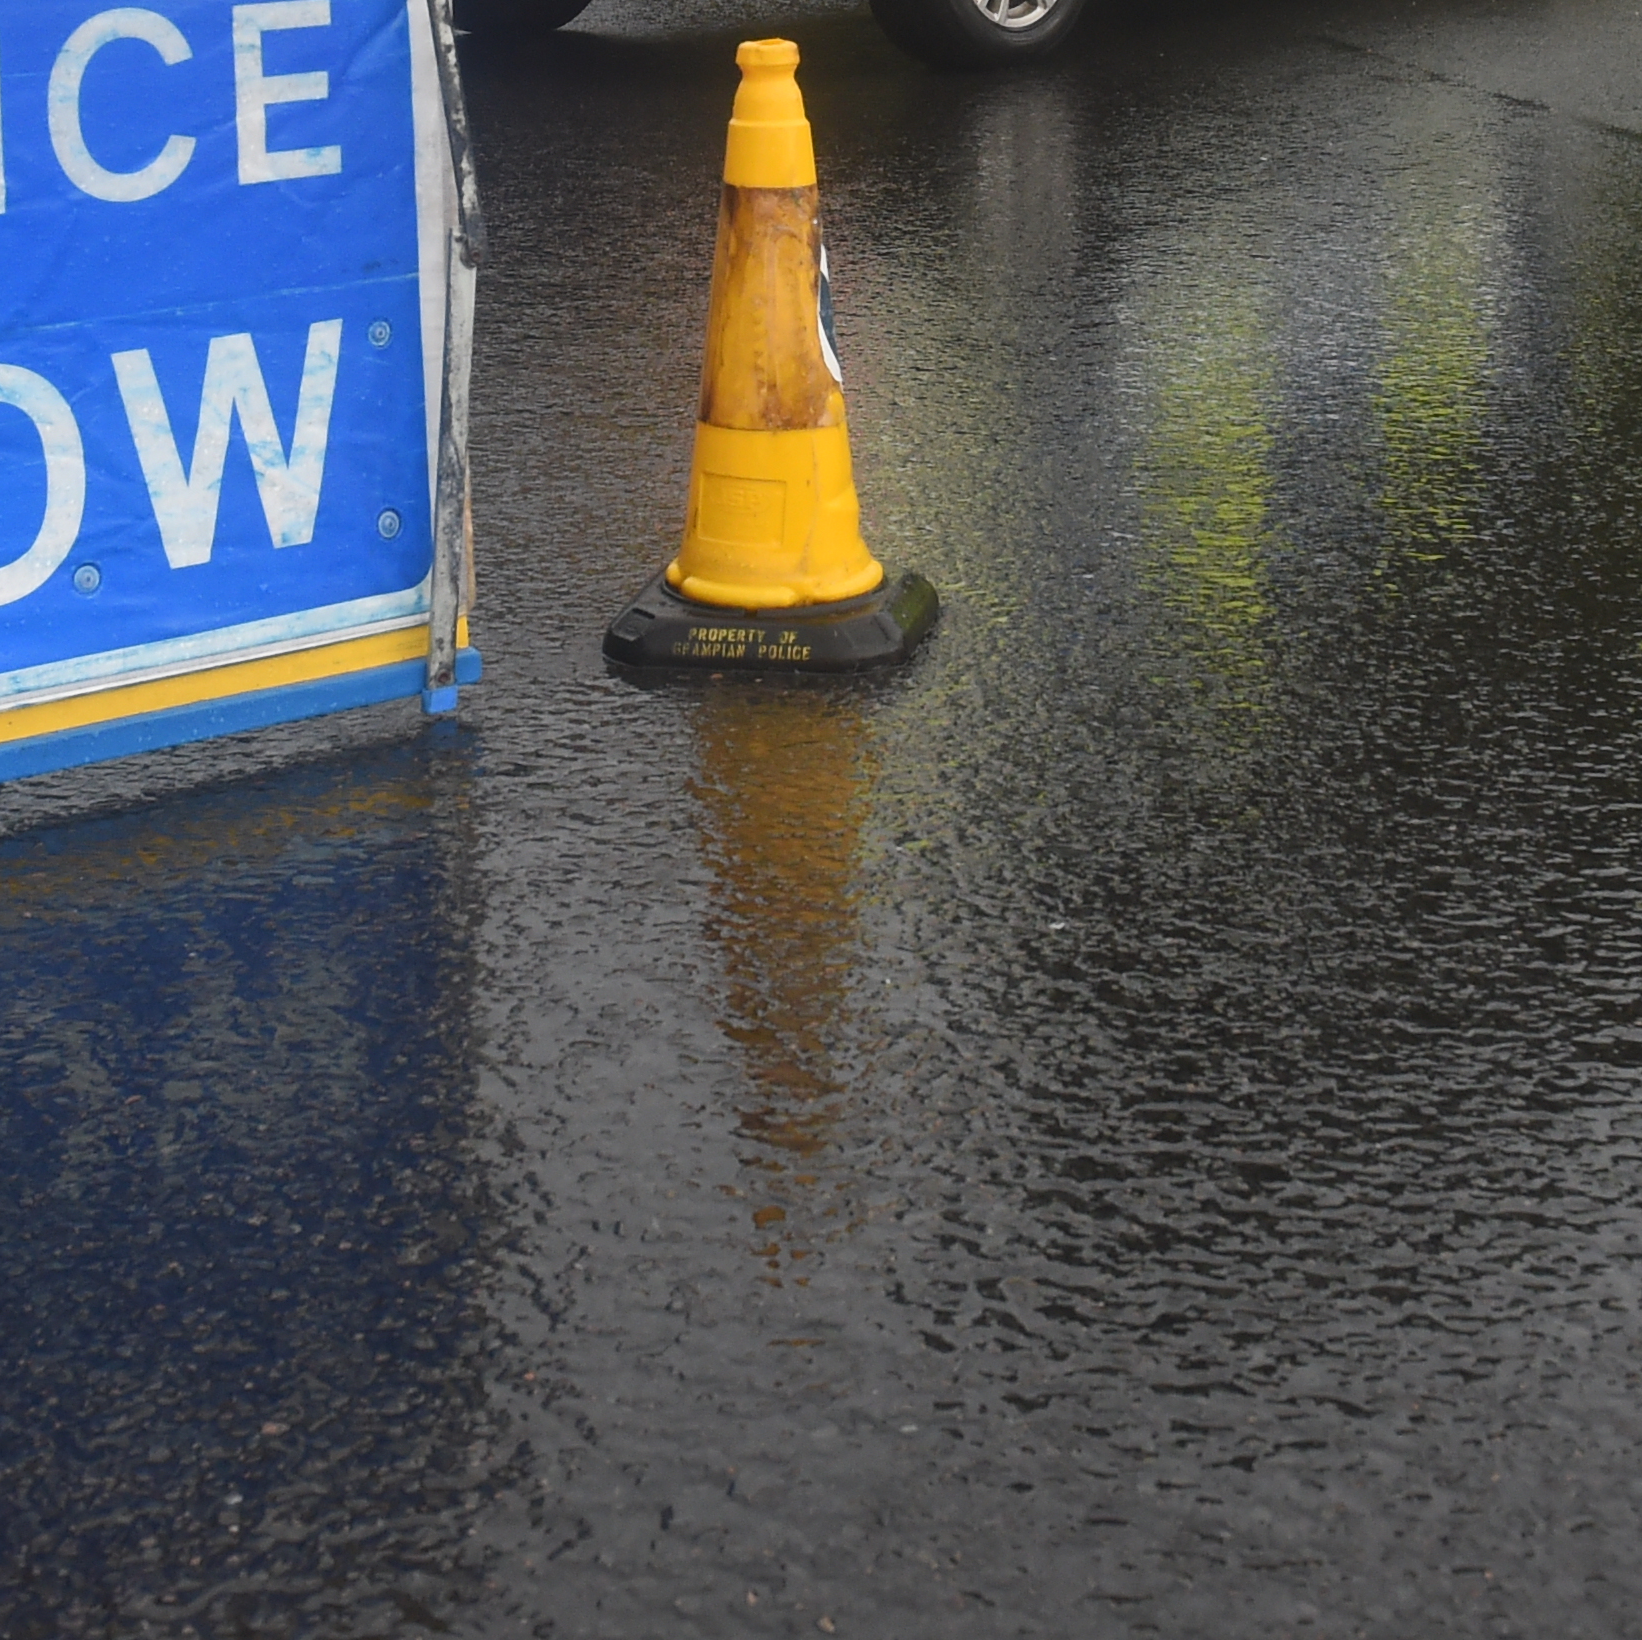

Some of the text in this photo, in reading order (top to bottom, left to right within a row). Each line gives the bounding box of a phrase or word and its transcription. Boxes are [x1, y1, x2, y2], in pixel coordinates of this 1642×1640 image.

[688, 627, 799, 645] PROPERTY OF
[758, 644, 812, 661] POLICE
